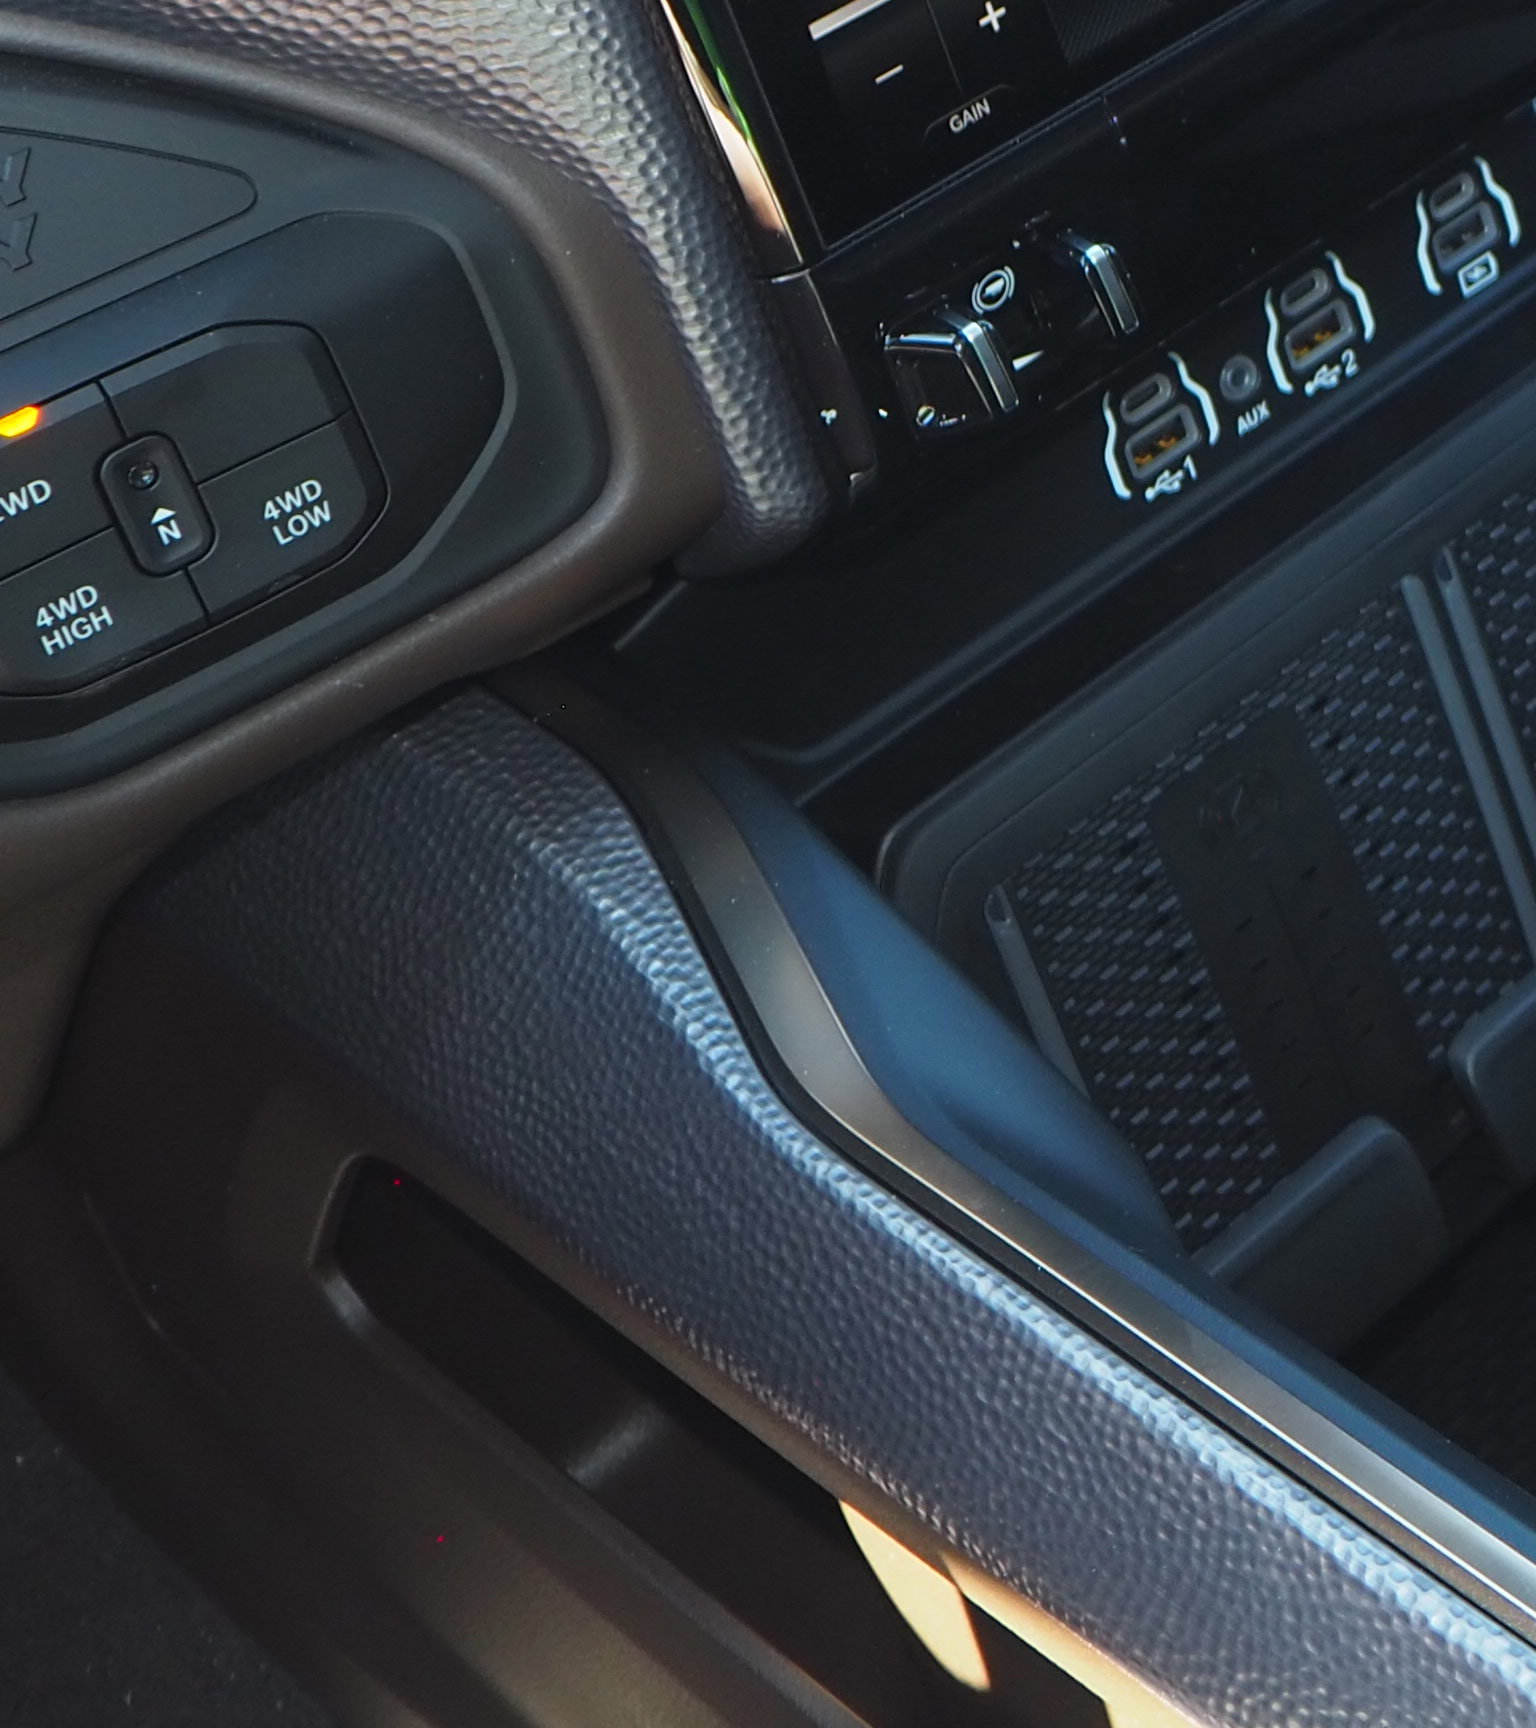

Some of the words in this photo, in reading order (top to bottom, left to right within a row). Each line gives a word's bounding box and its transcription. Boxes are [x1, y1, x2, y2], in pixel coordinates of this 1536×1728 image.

[949, 99, 990, 133] GAIN
[1342, 349, 1358, 375] 2
[1237, 402, 1270, 435] AUX
[1184, 455, 1197, 481] 1
[0, 479, 51, 523] WD
[264, 479, 323, 520] 4WD
[159, 520, 181, 546] N
[273, 502, 331, 545] LOW
[36, 585, 98, 628] 4WD
[41, 607, 114, 655] HIGH
